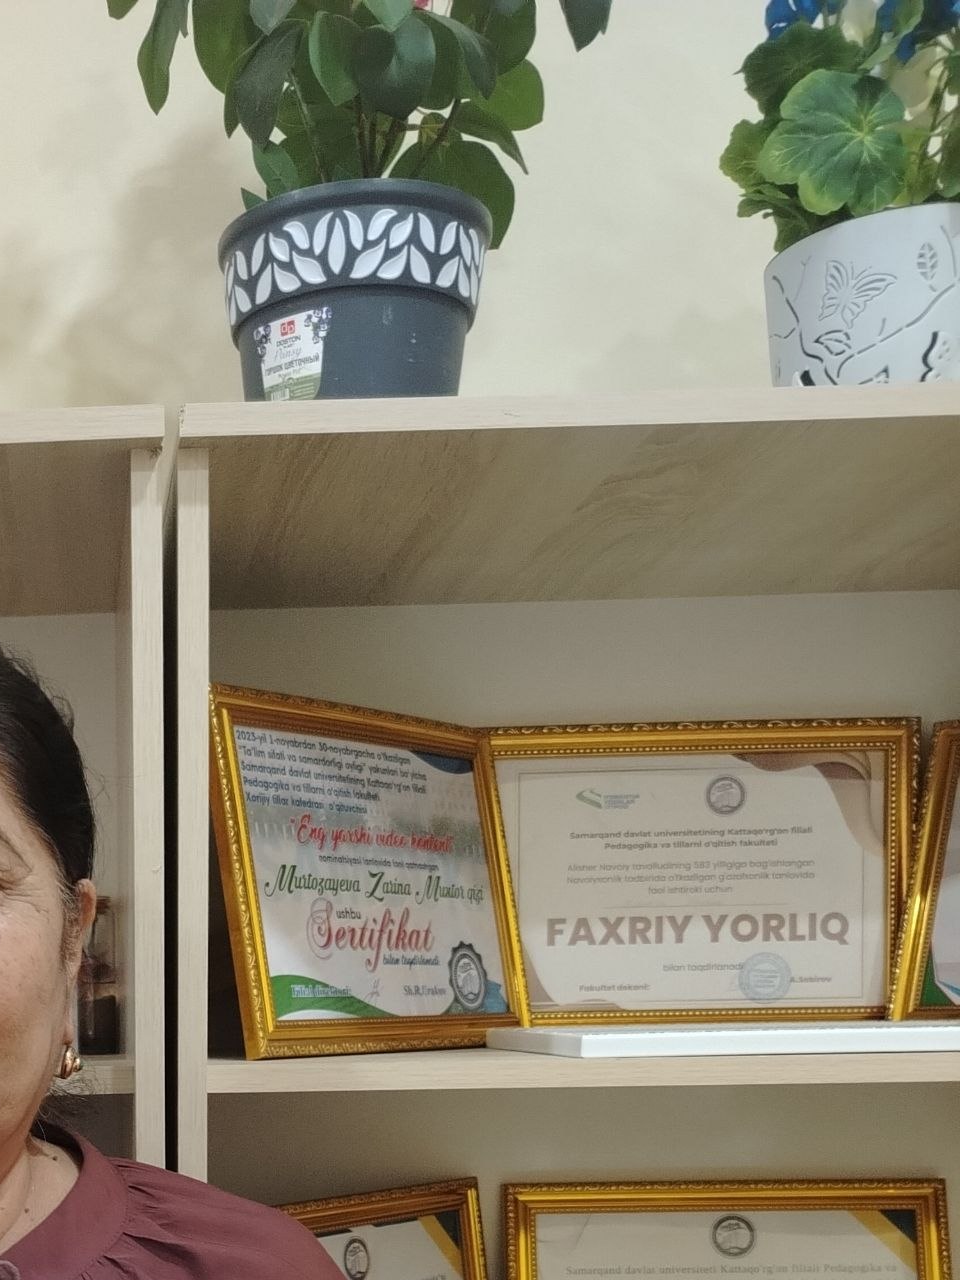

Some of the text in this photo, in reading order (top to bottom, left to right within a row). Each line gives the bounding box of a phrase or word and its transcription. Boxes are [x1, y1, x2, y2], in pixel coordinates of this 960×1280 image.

[241, 761, 287, 778] Samarqand
[243, 775, 290, 792] Pedagogika
[569, 831, 621, 840] Samarqand
[623, 830, 651, 838] davlat
[604, 841, 658, 851] Pedagogika
[264, 864, 361, 898] Murtozayeva
[365, 870, 411, 901] Zarina
[336, 907, 362, 920] ushbu
[307, 897, 435, 973] Sertifikat
[546, 911, 851, 946] FAXRIY YORLIQ
